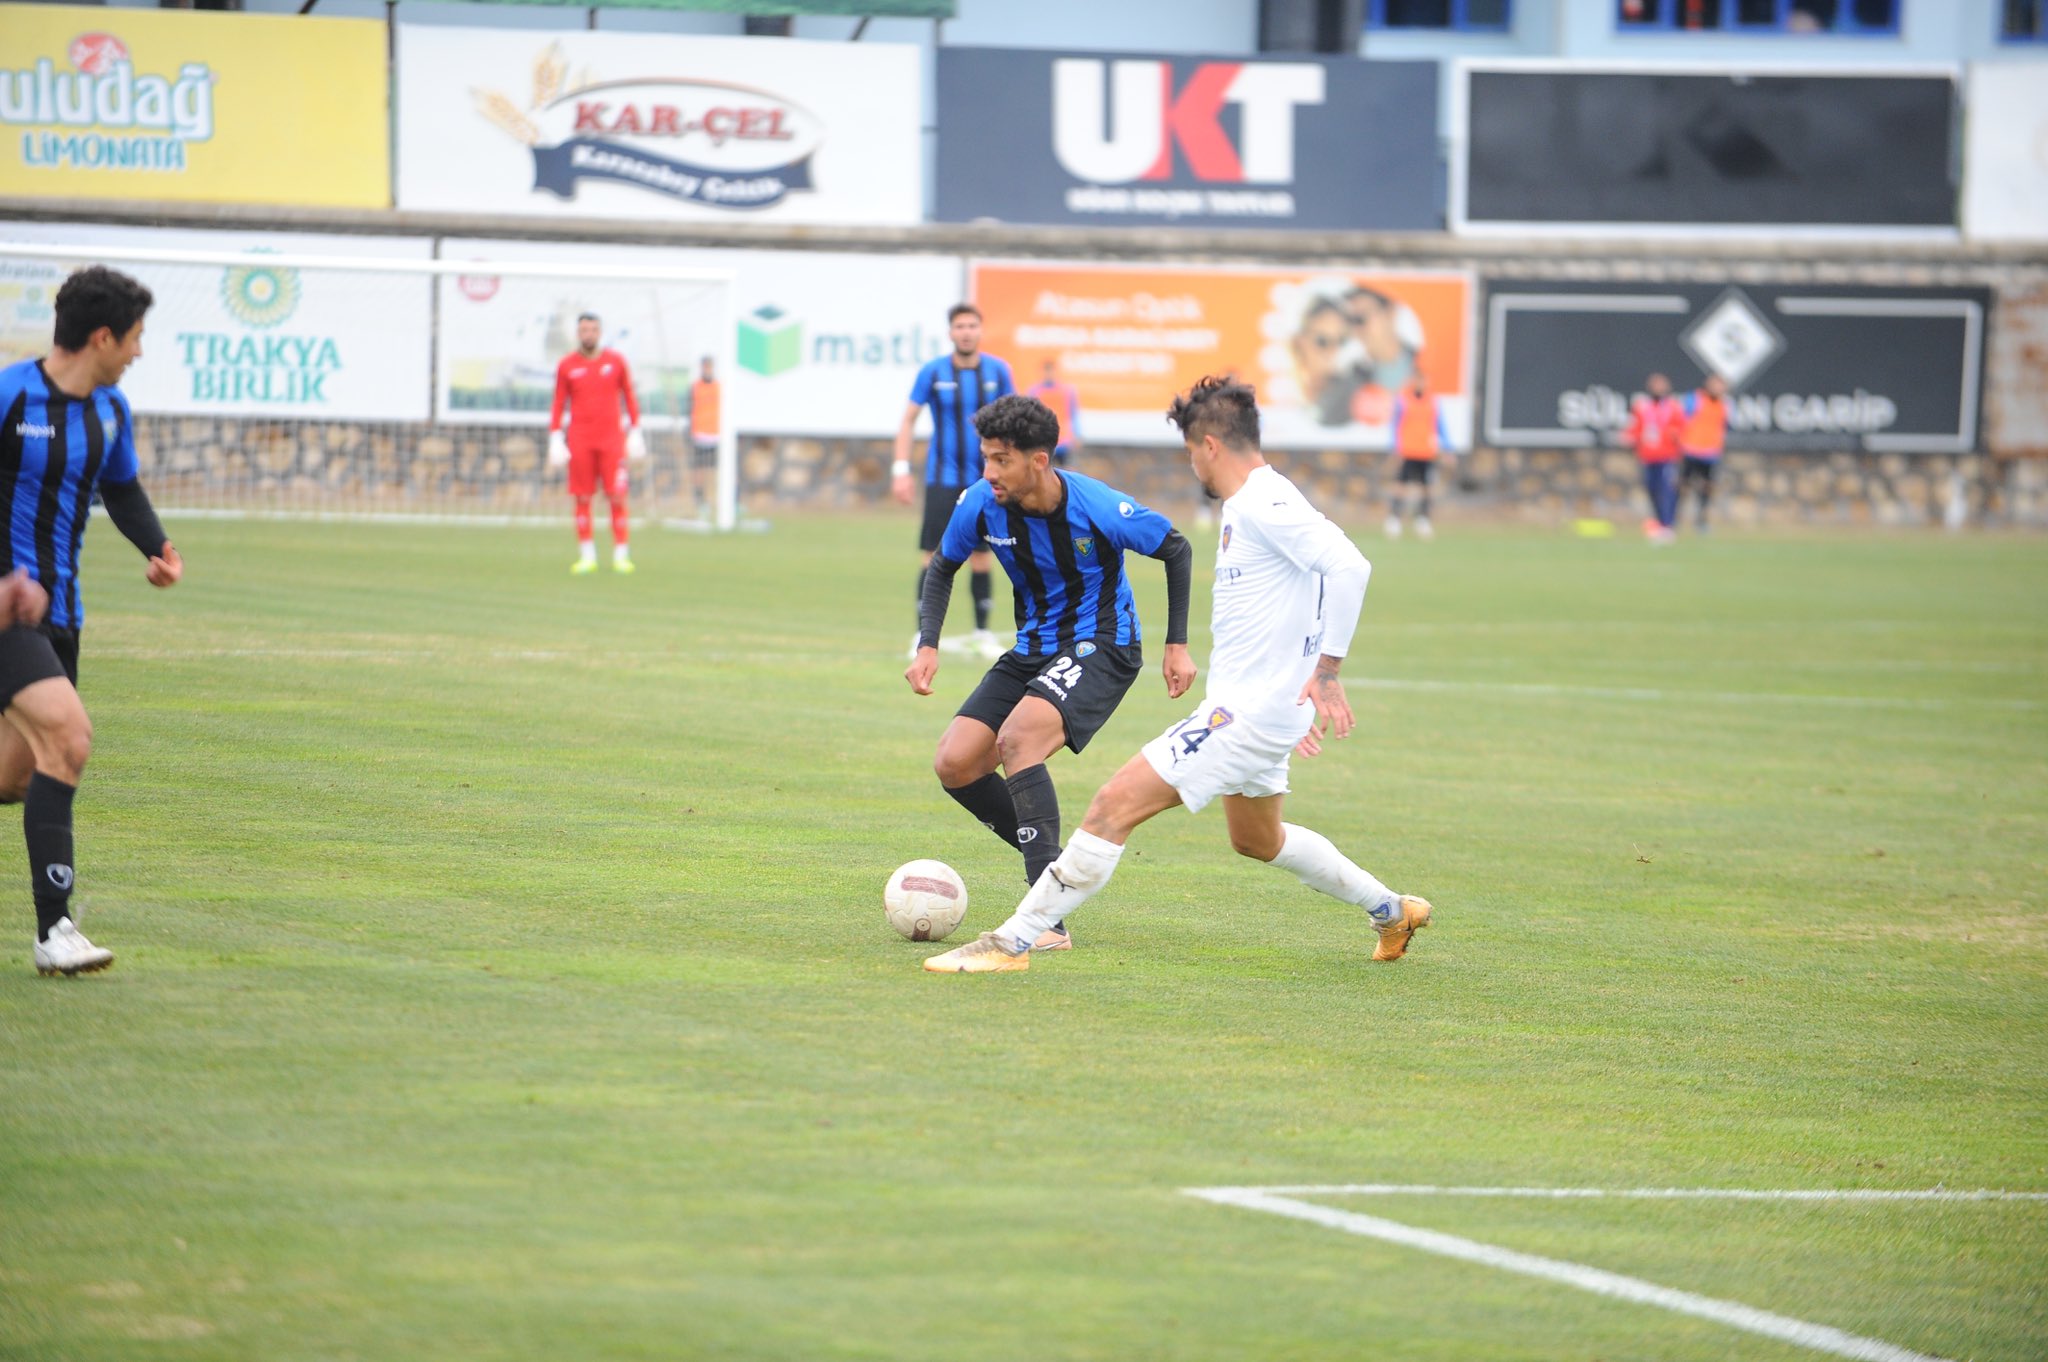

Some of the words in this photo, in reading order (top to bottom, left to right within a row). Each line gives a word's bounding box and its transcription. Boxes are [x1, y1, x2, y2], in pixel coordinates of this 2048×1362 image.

[575, 101, 793, 147] KAR-ÇEL
[1052, 58, 1325, 183] UKT
[177, 333, 342, 369] TRAKYA
[190, 366, 328, 403] BİRLİK
[1046, 656, 1083, 688] 24
